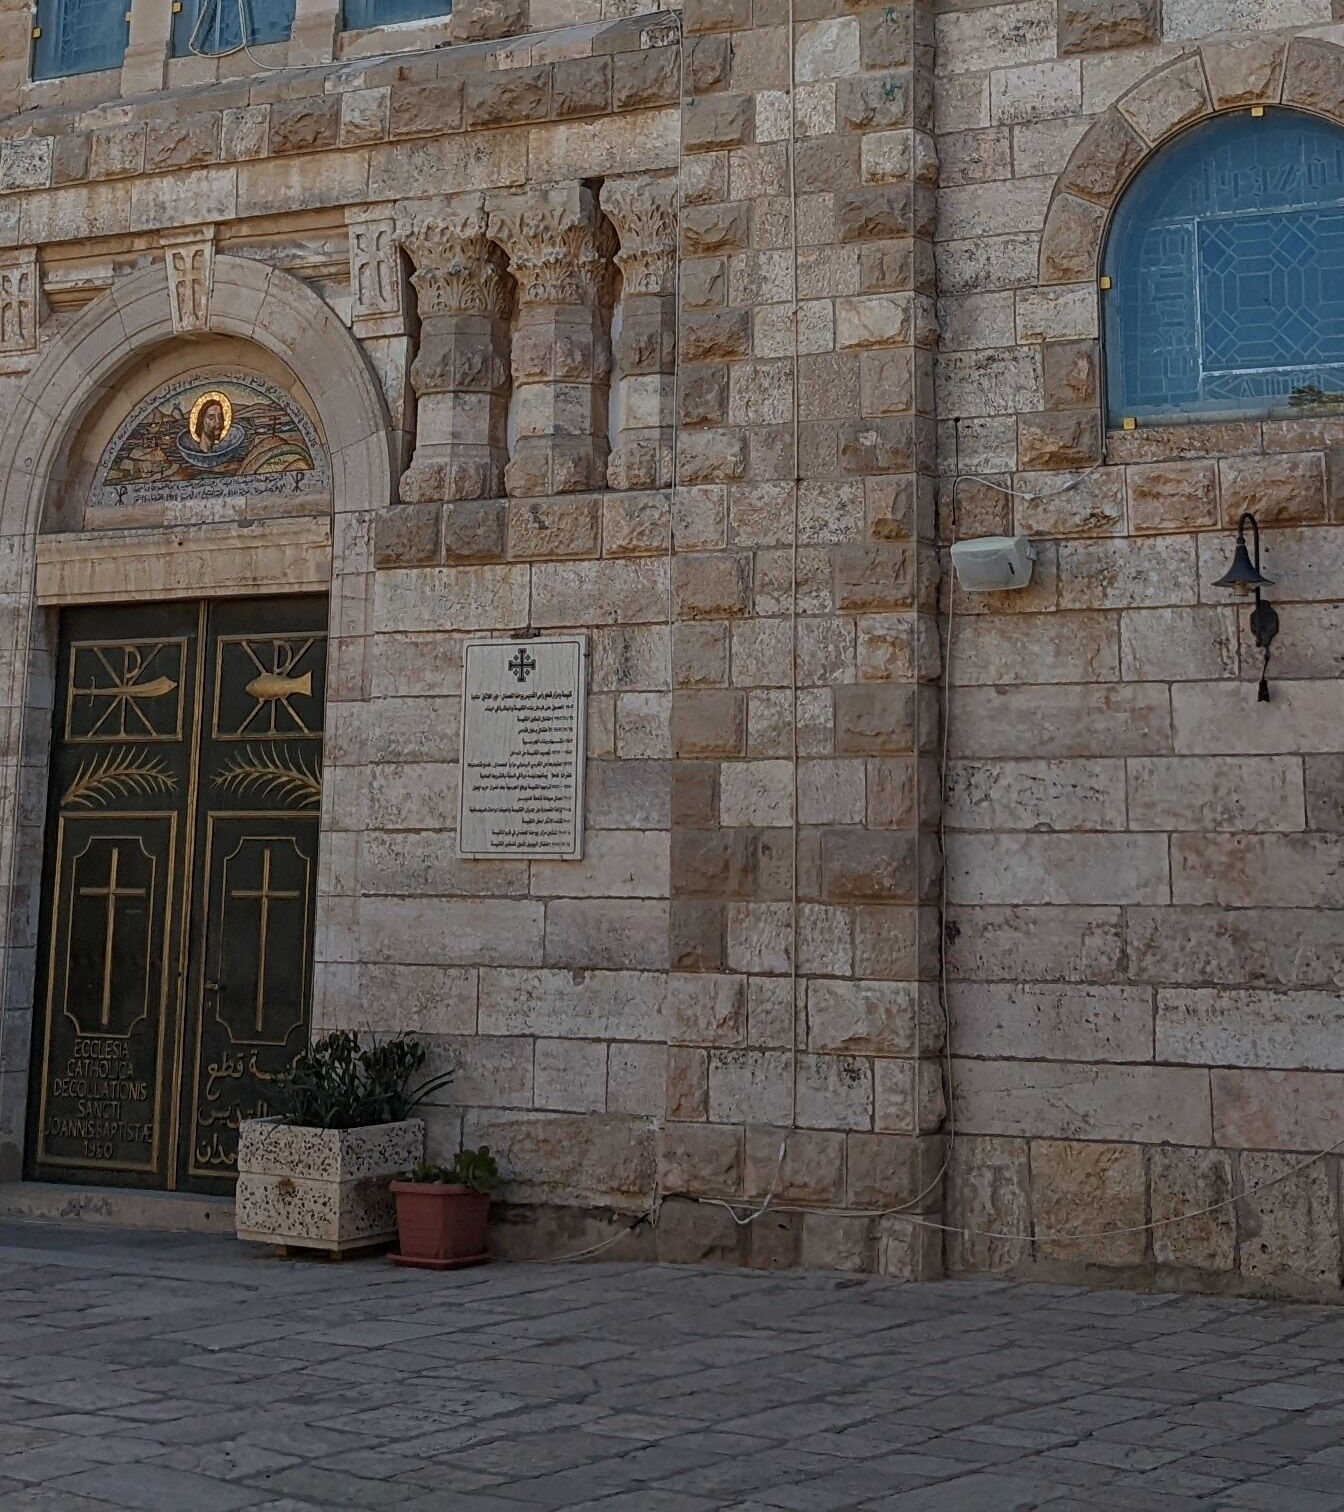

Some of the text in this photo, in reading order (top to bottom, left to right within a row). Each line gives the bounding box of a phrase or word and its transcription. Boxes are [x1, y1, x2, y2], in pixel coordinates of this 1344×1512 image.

[74, 1039, 130, 1059] ECCLESIA
[67, 1058, 134, 1079] CATHOLICA
[207, 1049, 245, 1102] قطع
[53, 1078, 148, 1101] DECOLLATIONIS
[78, 1100, 121, 1119] SANCTI
